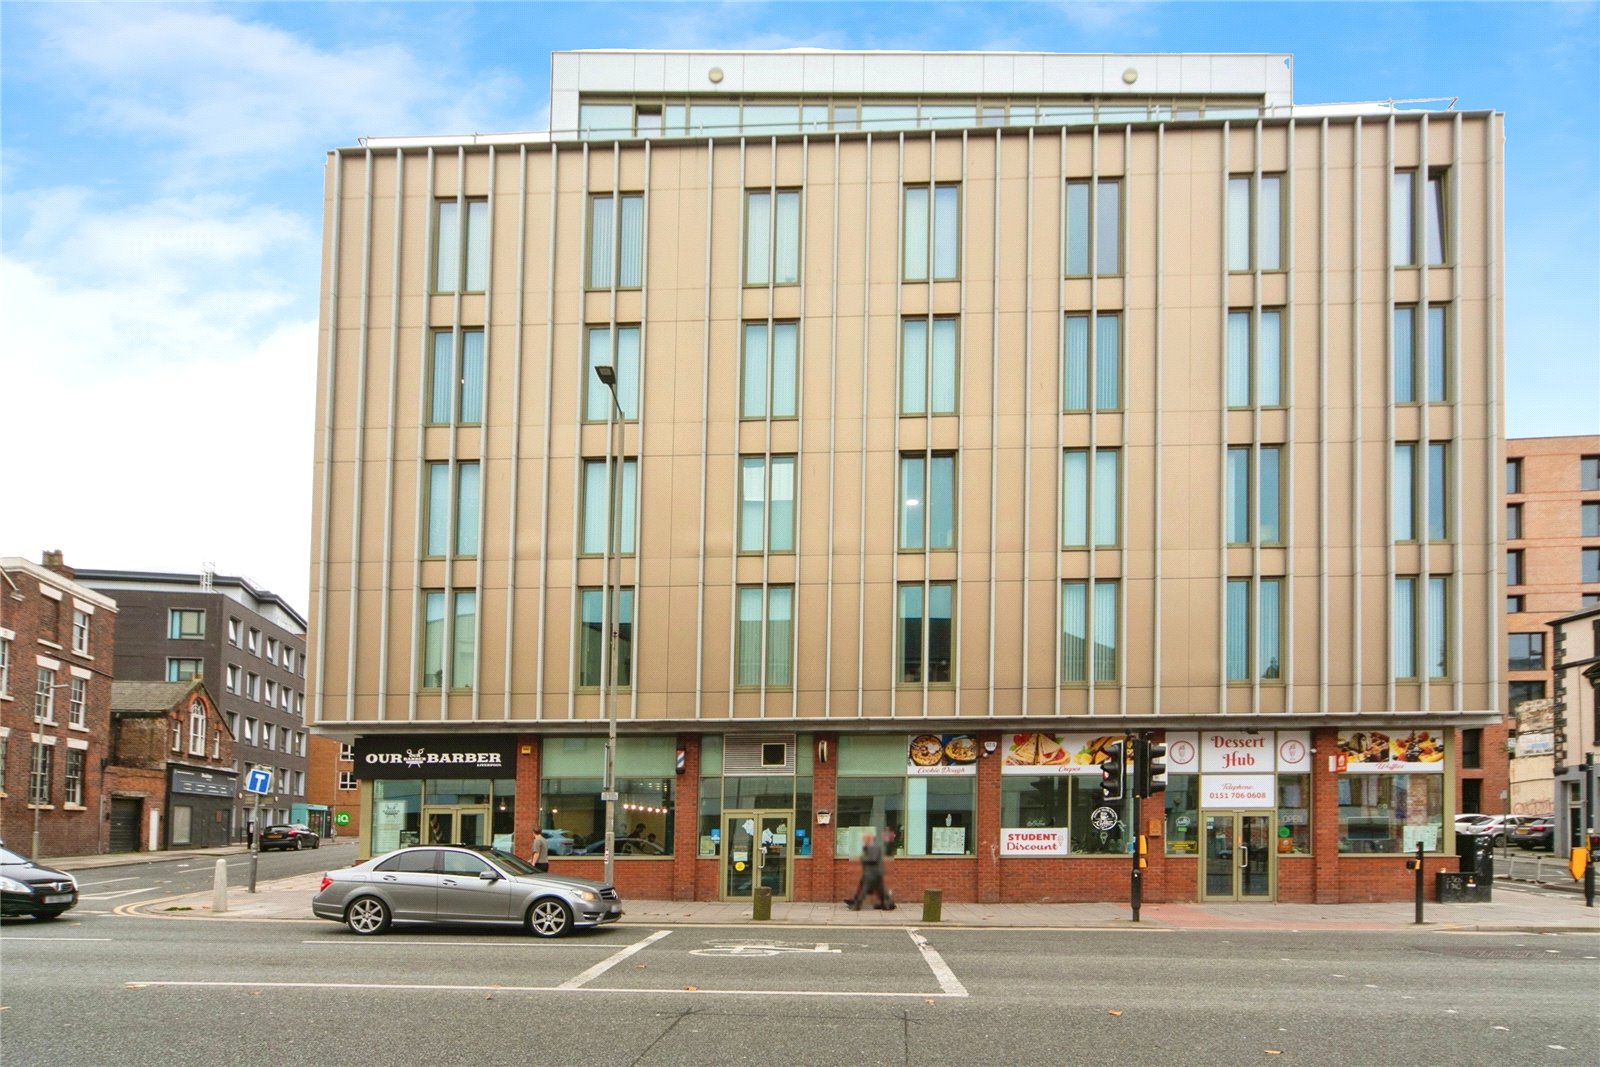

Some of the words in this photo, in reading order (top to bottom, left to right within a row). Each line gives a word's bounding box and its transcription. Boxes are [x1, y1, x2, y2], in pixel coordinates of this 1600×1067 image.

[1210, 735, 1266, 748] Dessert
[365, 753, 403, 764] OUR
[426, 752, 502, 764] BARBER
[1222, 751, 1255, 769] Hub
[337, 814, 349, 823] iQ
[1008, 833, 1058, 841] STUDENT
[1006, 842, 1057, 851] Discount
